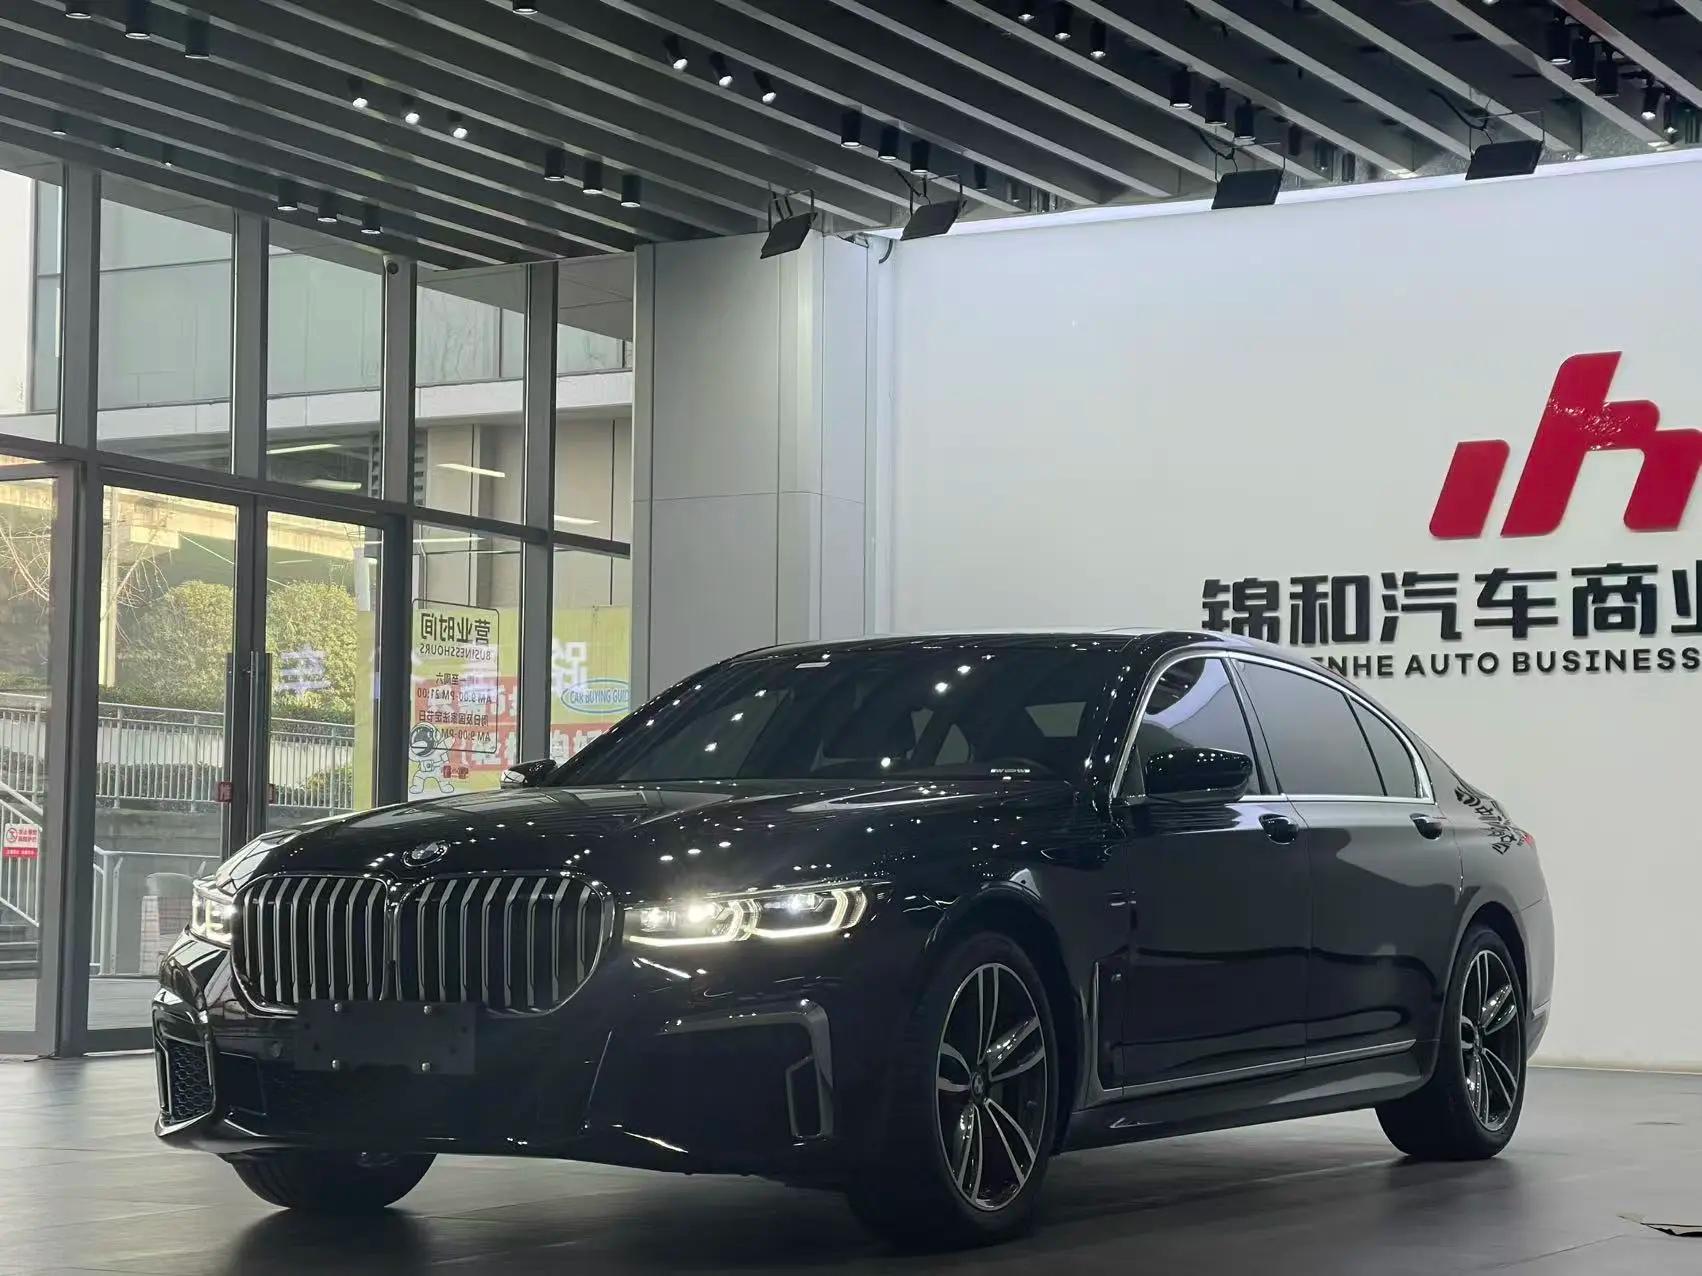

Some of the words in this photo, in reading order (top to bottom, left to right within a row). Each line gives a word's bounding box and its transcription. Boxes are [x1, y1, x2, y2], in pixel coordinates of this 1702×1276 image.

[1310, 654, 1393, 677] NHE
[1405, 651, 1499, 676] AUTO
[1512, 647, 1701, 673] BUSINESS
